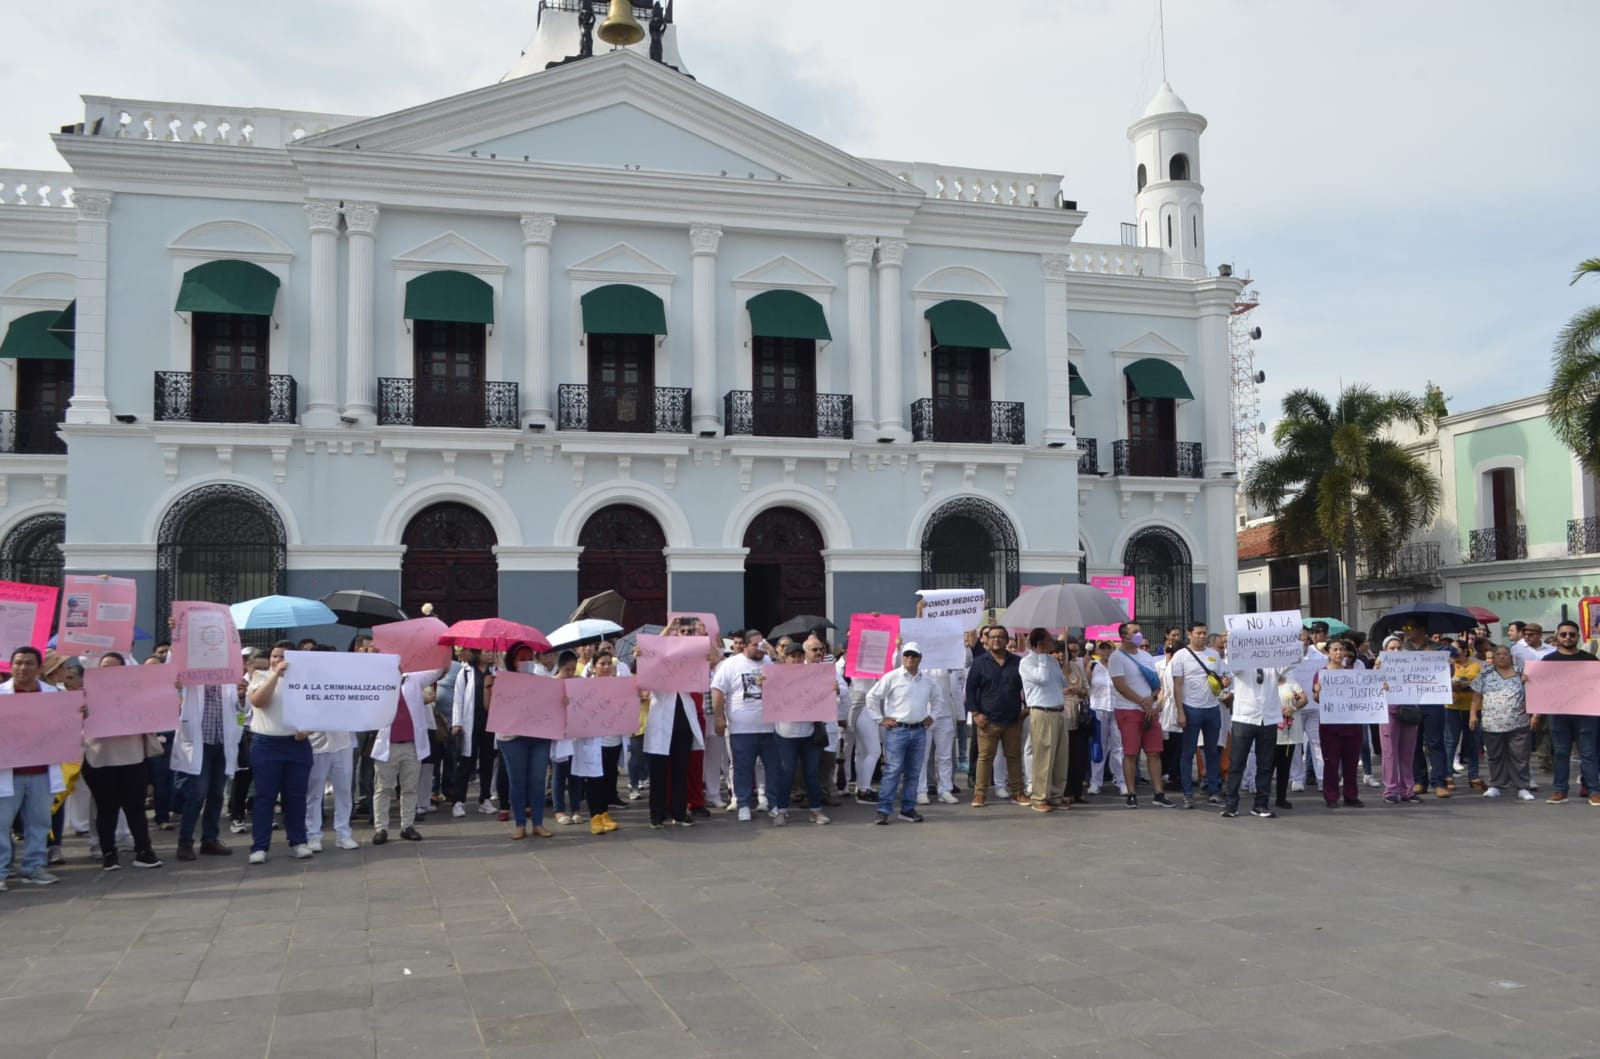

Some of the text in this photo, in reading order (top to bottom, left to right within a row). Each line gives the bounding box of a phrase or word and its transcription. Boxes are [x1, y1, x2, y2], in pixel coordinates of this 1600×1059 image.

[1487, 587, 1545, 601] OPTICAS
[952, 595, 984, 604] MEDICOS
[940, 607, 977, 617] ASESINOS
[1247, 616, 1264, 631] NO
[1269, 617, 1276, 629] A
[1281, 615, 1293, 628] LA
[1251, 649, 1270, 659] ACTO
[288, 683, 301, 691] NO
[1323, 701, 1335, 713] NO
